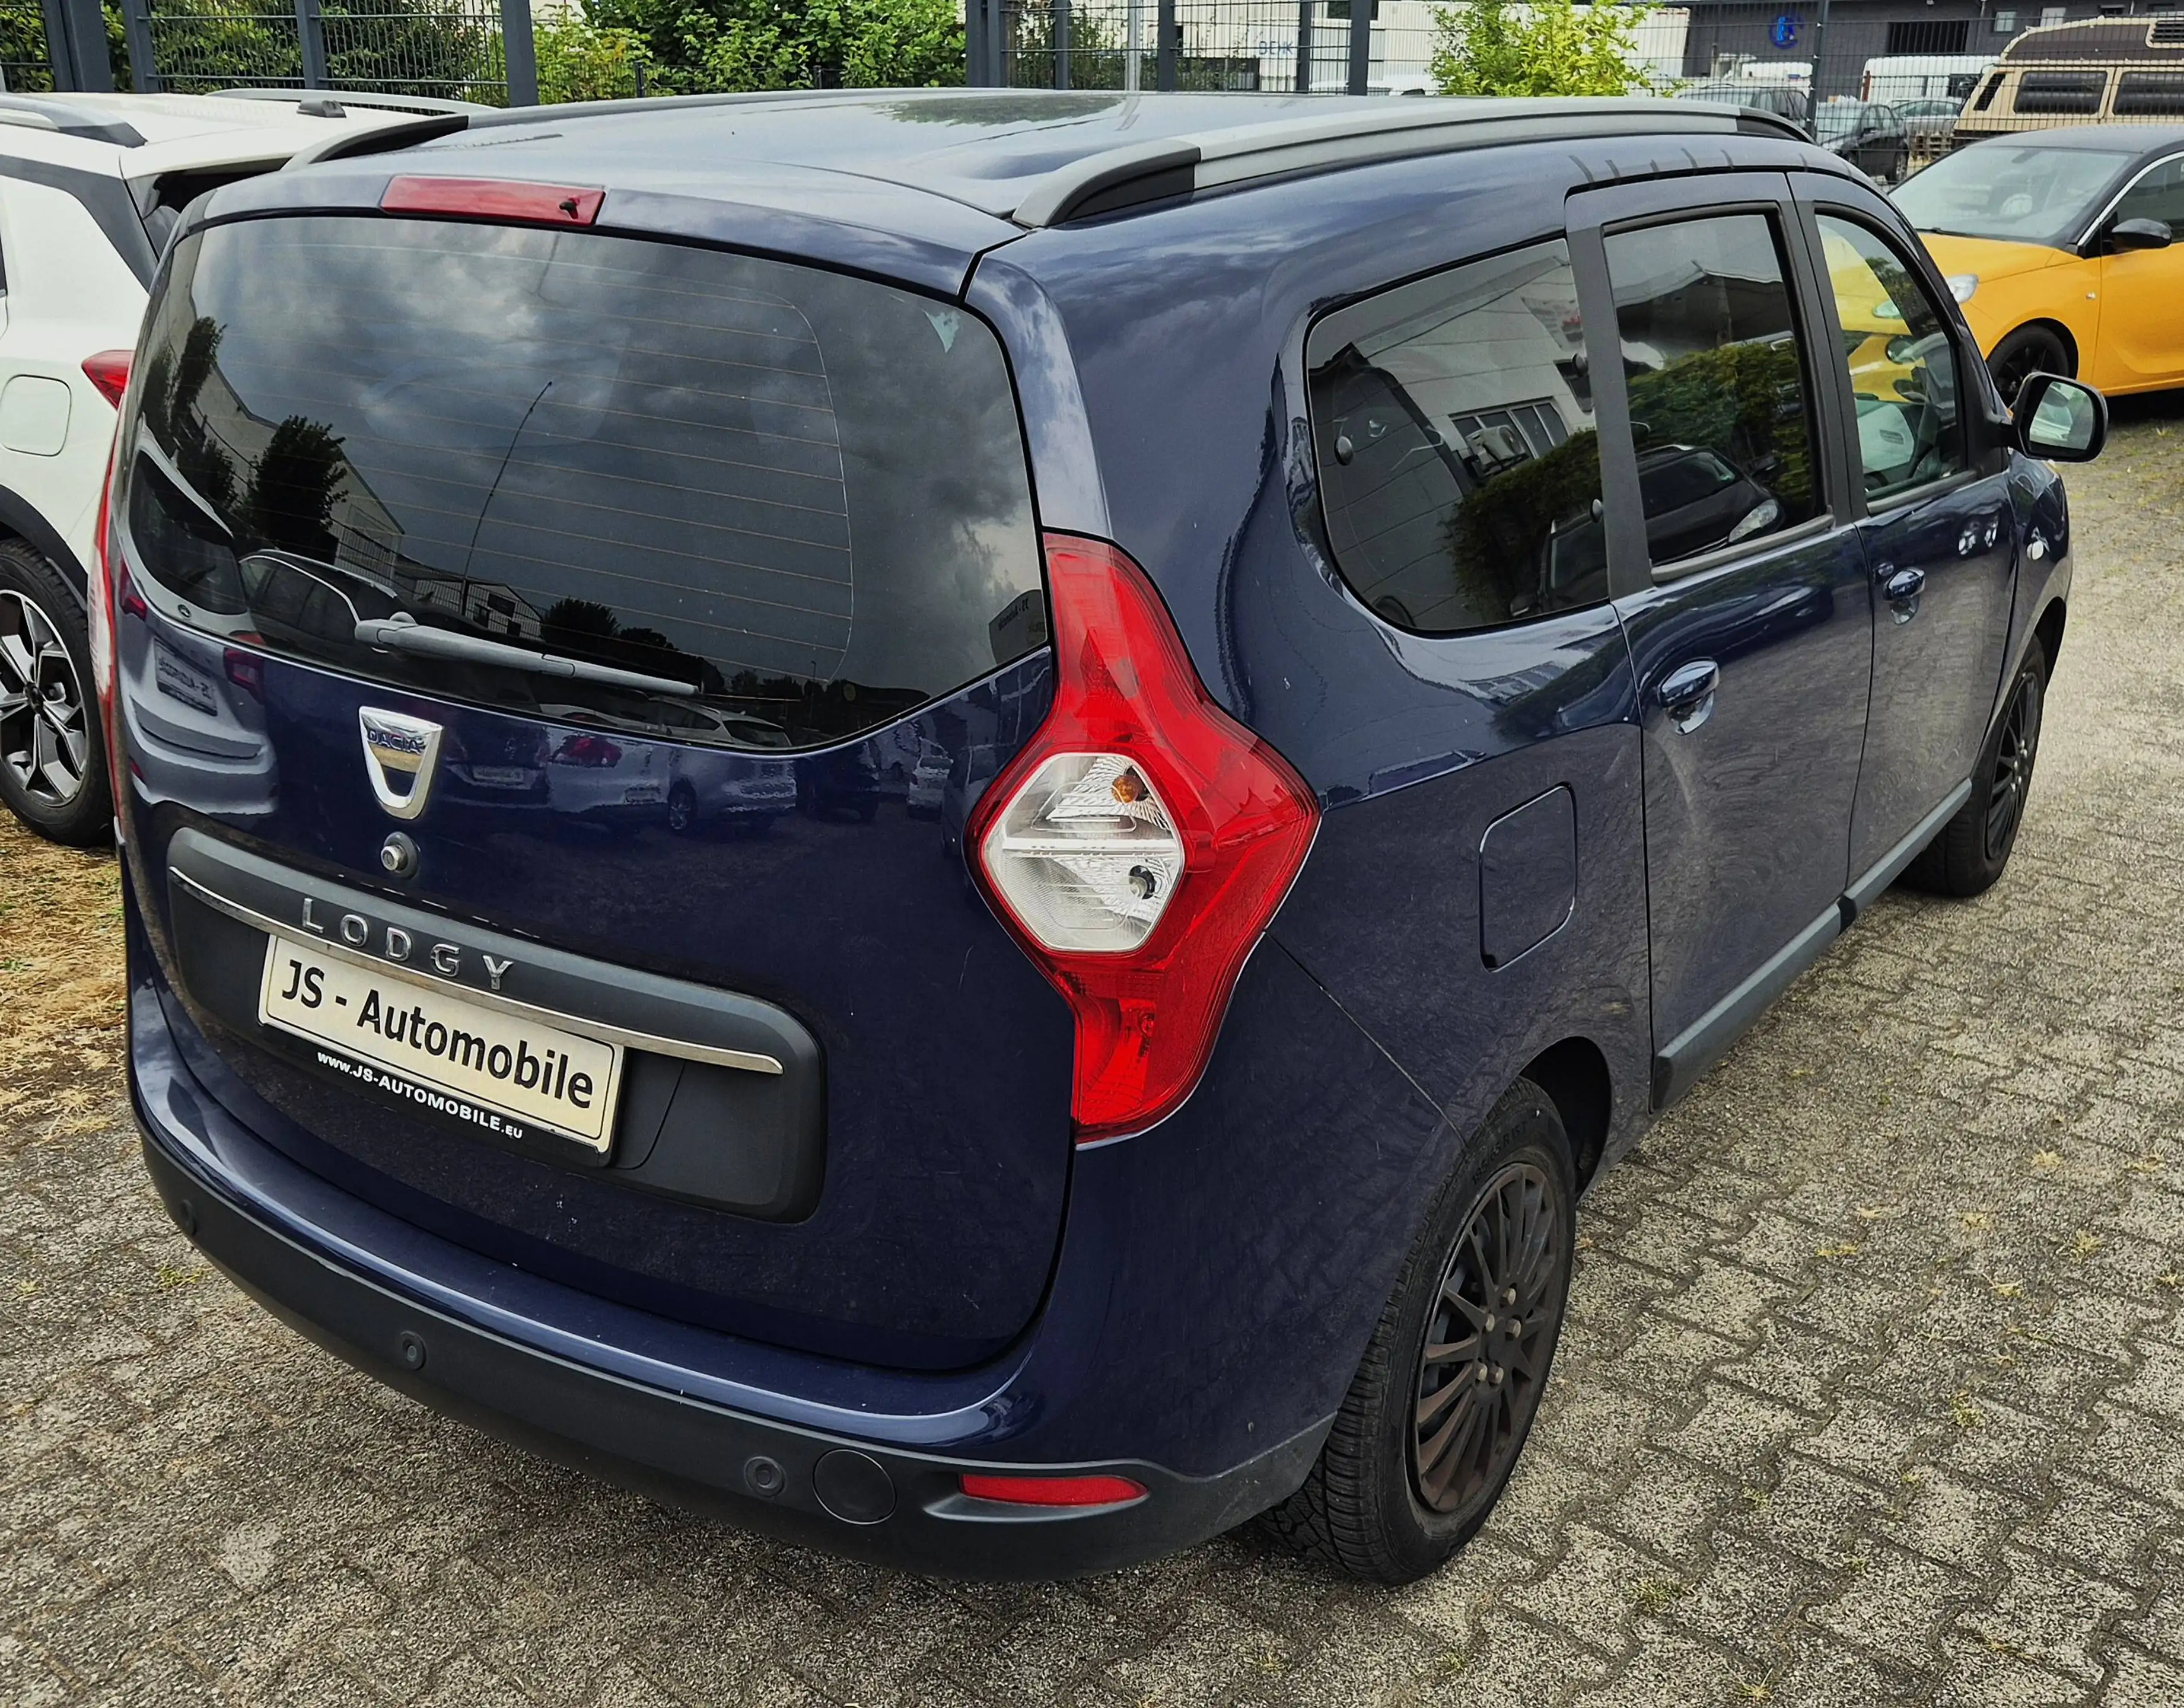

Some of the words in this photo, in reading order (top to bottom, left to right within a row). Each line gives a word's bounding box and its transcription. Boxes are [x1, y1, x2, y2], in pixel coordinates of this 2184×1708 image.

[368, 730, 422, 754] DACIA
[302, 898, 514, 990] LODGY
[282, 959, 325, 1009] JS
[356, 989, 593, 1109] Automobile
[317, 1051, 523, 1139] www.JS-AUTOMOBILE.EU
